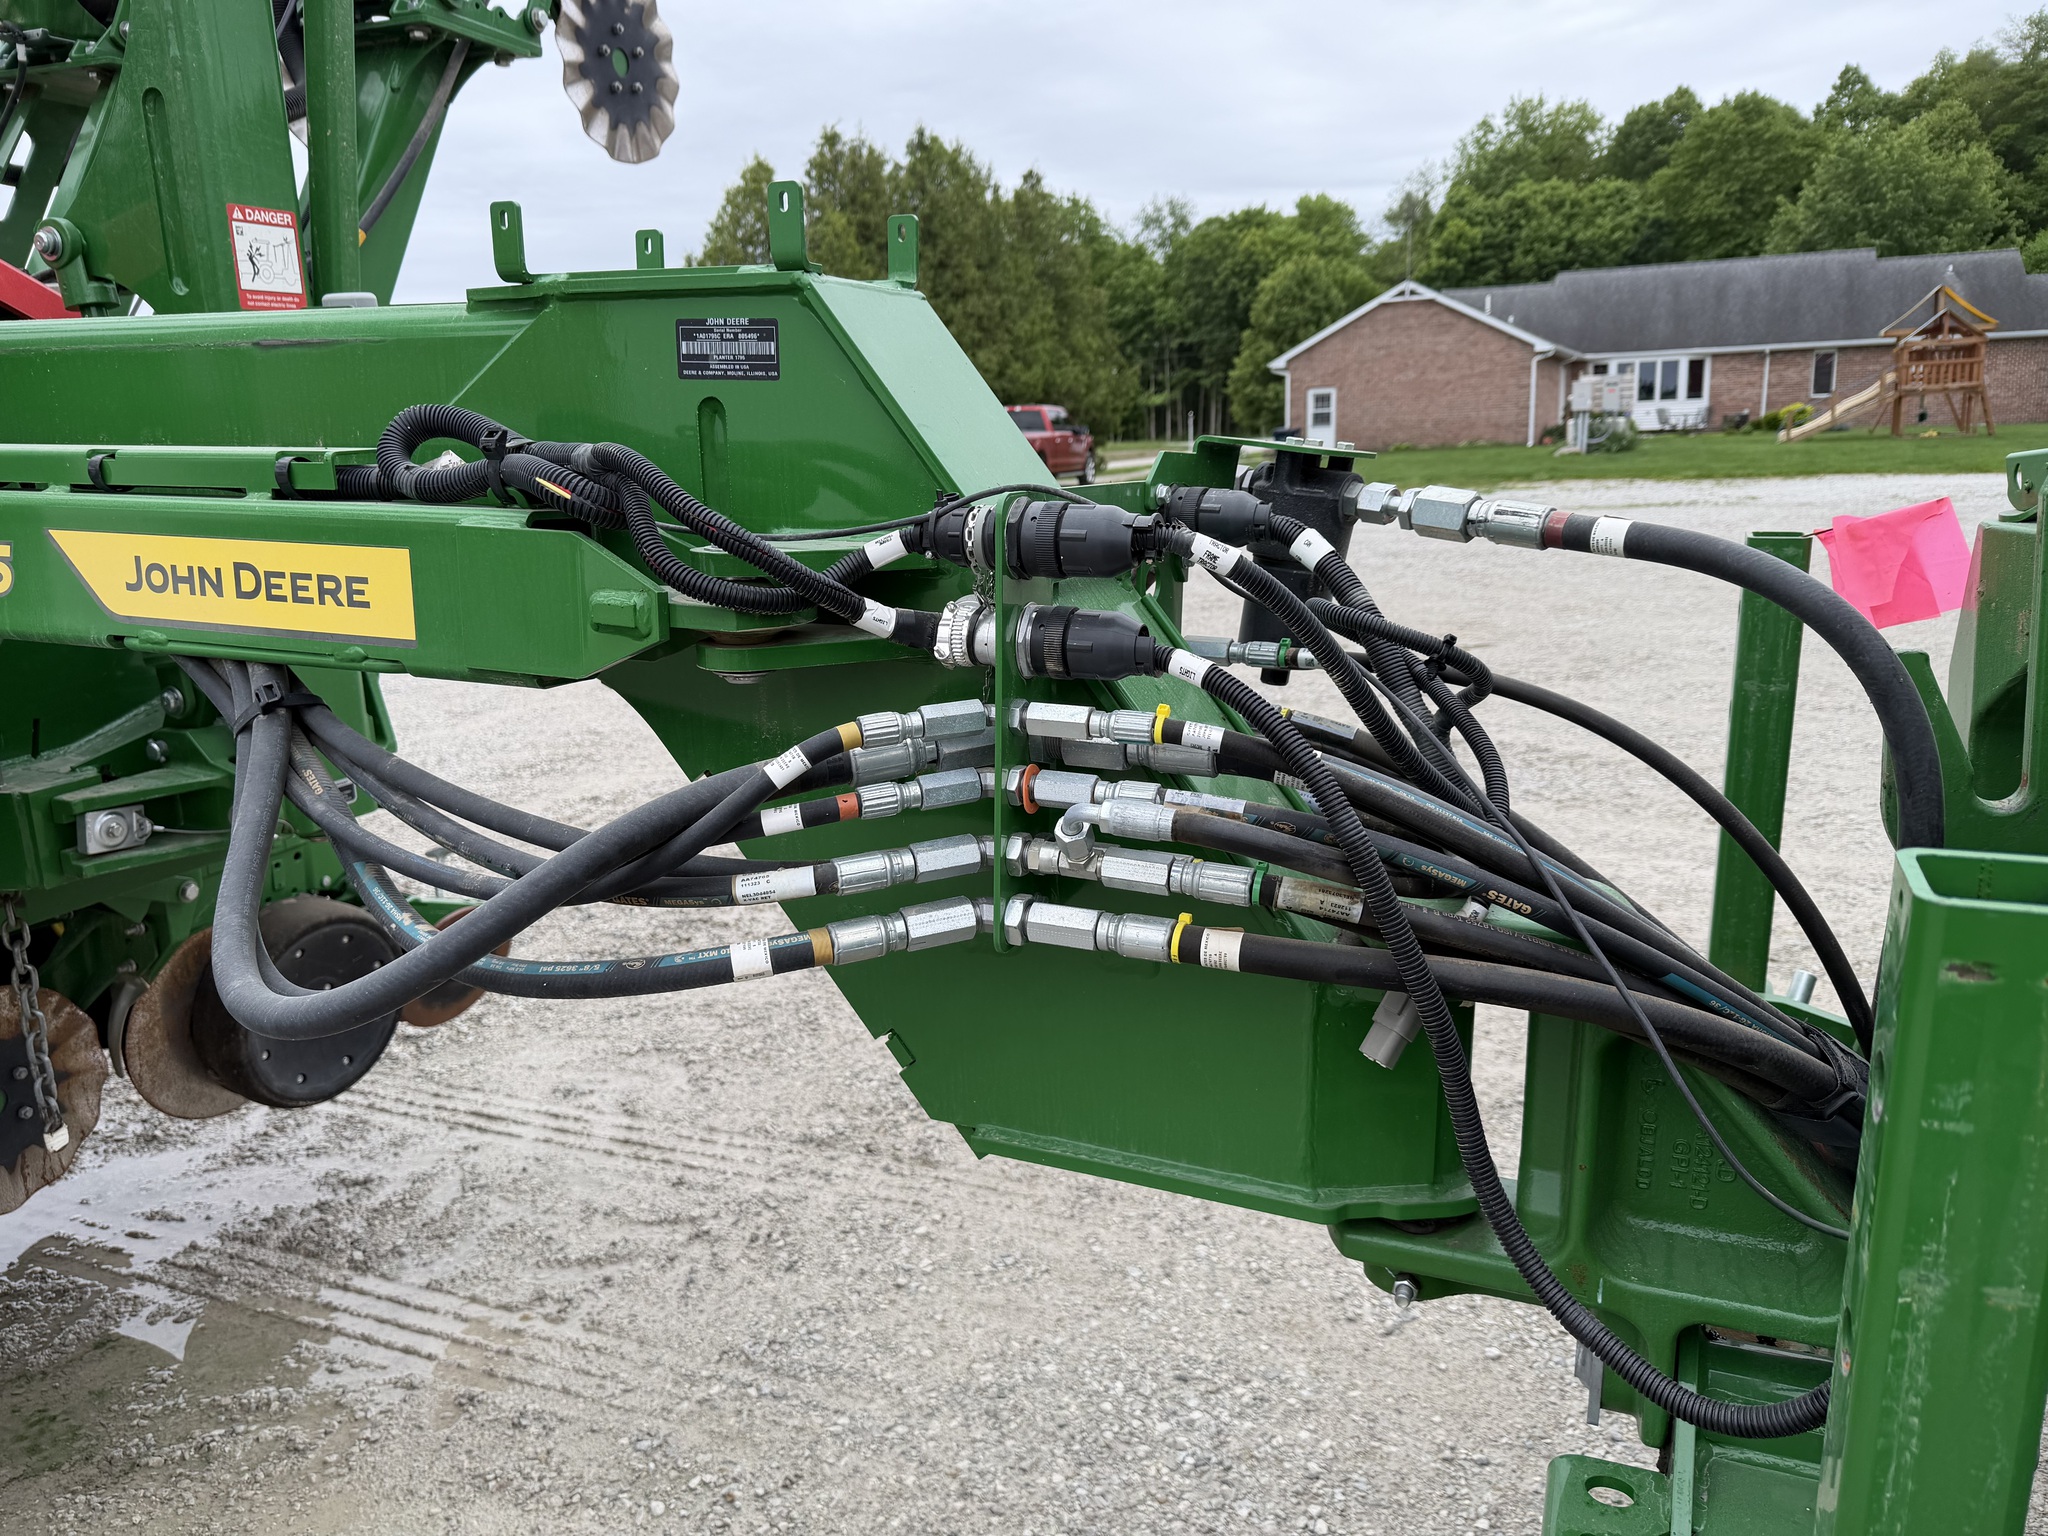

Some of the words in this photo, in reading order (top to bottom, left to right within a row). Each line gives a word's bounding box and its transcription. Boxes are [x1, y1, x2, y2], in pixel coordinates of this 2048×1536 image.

[245, 208, 292, 226] DANGER
[727, 318, 749, 326] DEERE
[1209, 540, 1230, 554] TRACTOR
[125, 556, 224, 598] JOHN
[233, 562, 371, 609] DEERE
[873, 616, 888, 626] LIGHTS
[1179, 666, 1196, 680] LIGHTS
[304, 769, 325, 796] GATES
[1420, 864, 1467, 887] MEGASys
[1487, 889, 1532, 915] GATES
